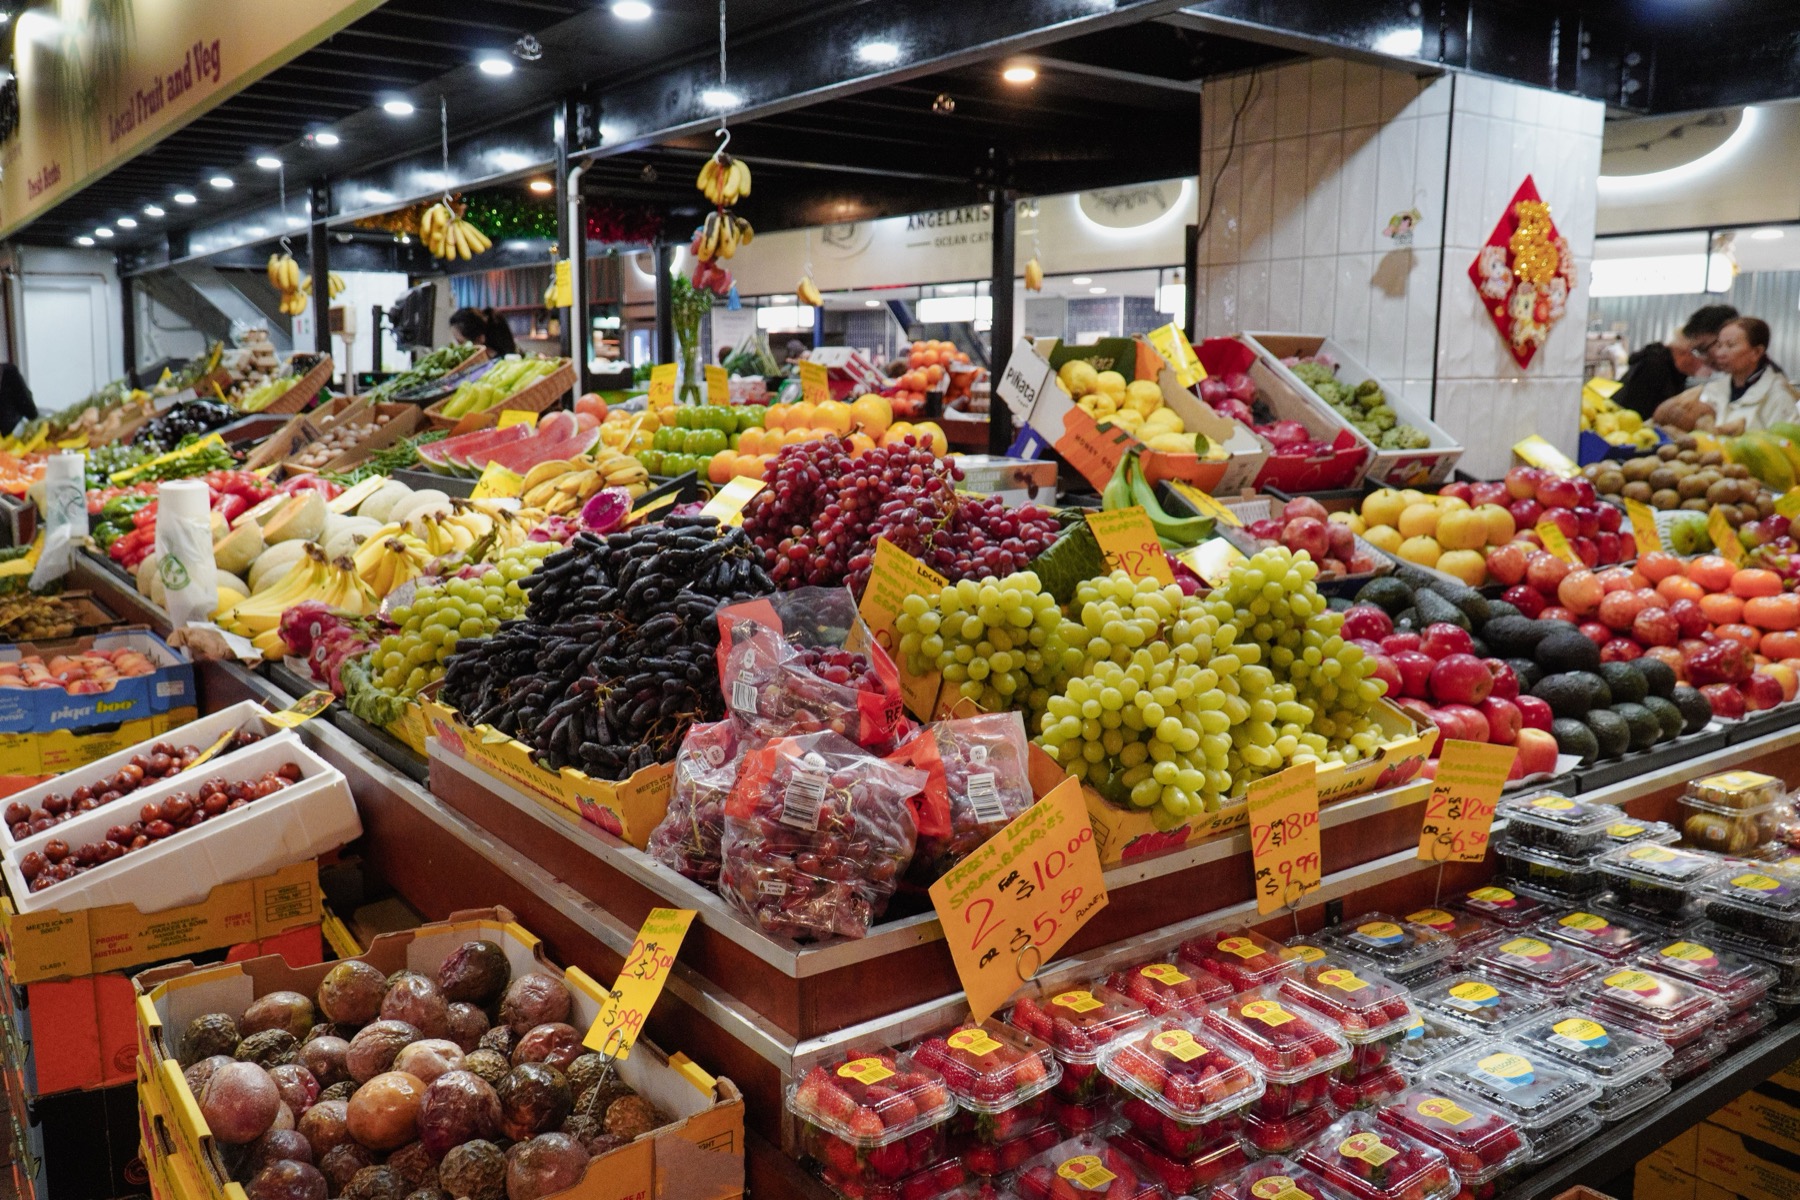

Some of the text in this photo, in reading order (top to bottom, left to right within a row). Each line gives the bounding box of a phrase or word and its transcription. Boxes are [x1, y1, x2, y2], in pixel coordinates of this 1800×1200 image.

[108, 39, 221, 144] Local Fruit and Veg
[906, 206, 991, 232] ANGELAKIS
[916, 565, 945, 588] LOCAL
[95, 699, 134, 715] boo
[500, 755, 566, 798] AUSTRALIAN
[635, 782, 660, 796] MEETS
[1425, 793, 1447, 820] 2
[1448, 796, 1462, 805] FOR
[1252, 824, 1273, 858] 2
[1271, 818, 1283, 830] FOR
[1422, 824, 1440, 836] OR
[944, 845, 996, 891] FRESH
[1006, 801, 1054, 842] LOCAL
[1255, 867, 1271, 881] OR
[964, 897, 1006, 951] 2
[997, 869, 1021, 893] FOR
[25, 922, 50, 931] MEETS
[151, 922, 181, 935] PARKER
[188, 918, 209, 928] SONS
[95, 933, 130, 945] PRODUCE
[168, 935, 202, 948] AUSTRALIA
[93, 945, 134, 959] AUSTRALIA
[620, 938, 645, 979] 2
[979, 947, 1001, 970] OR
[608, 989, 623, 1003] OR
